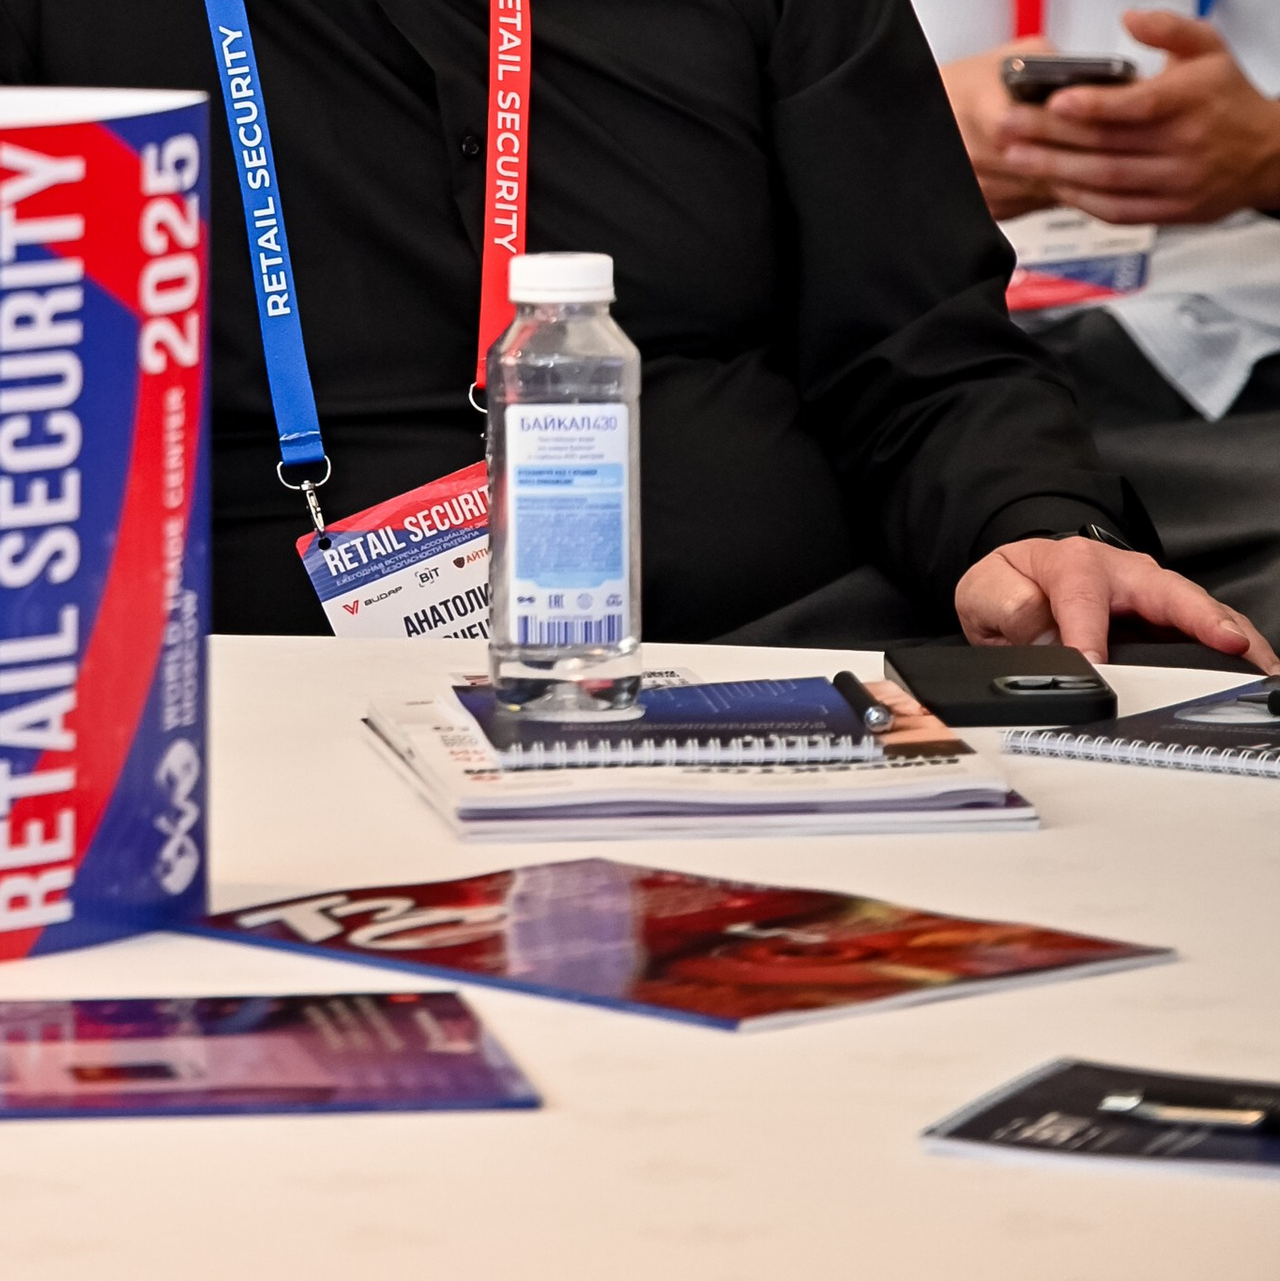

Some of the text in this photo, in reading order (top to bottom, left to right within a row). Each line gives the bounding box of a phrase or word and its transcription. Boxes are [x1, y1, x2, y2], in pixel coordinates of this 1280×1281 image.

[218, 25, 291, 318] RETAIL SECURITY
[493, 90, 521, 255] SECURITY
[139, 134, 202, 377] 2025
[323, 525, 406, 577] RETAIL
[403, 486, 489, 543] SECURIT
[381, 531, 479, 575] БЕЗОПАСНОСТИ РИТЕЙЛА
[384, 548, 419, 567] ВСТРЕЧА
[403, 582, 489, 638] АНАТОЛИ
